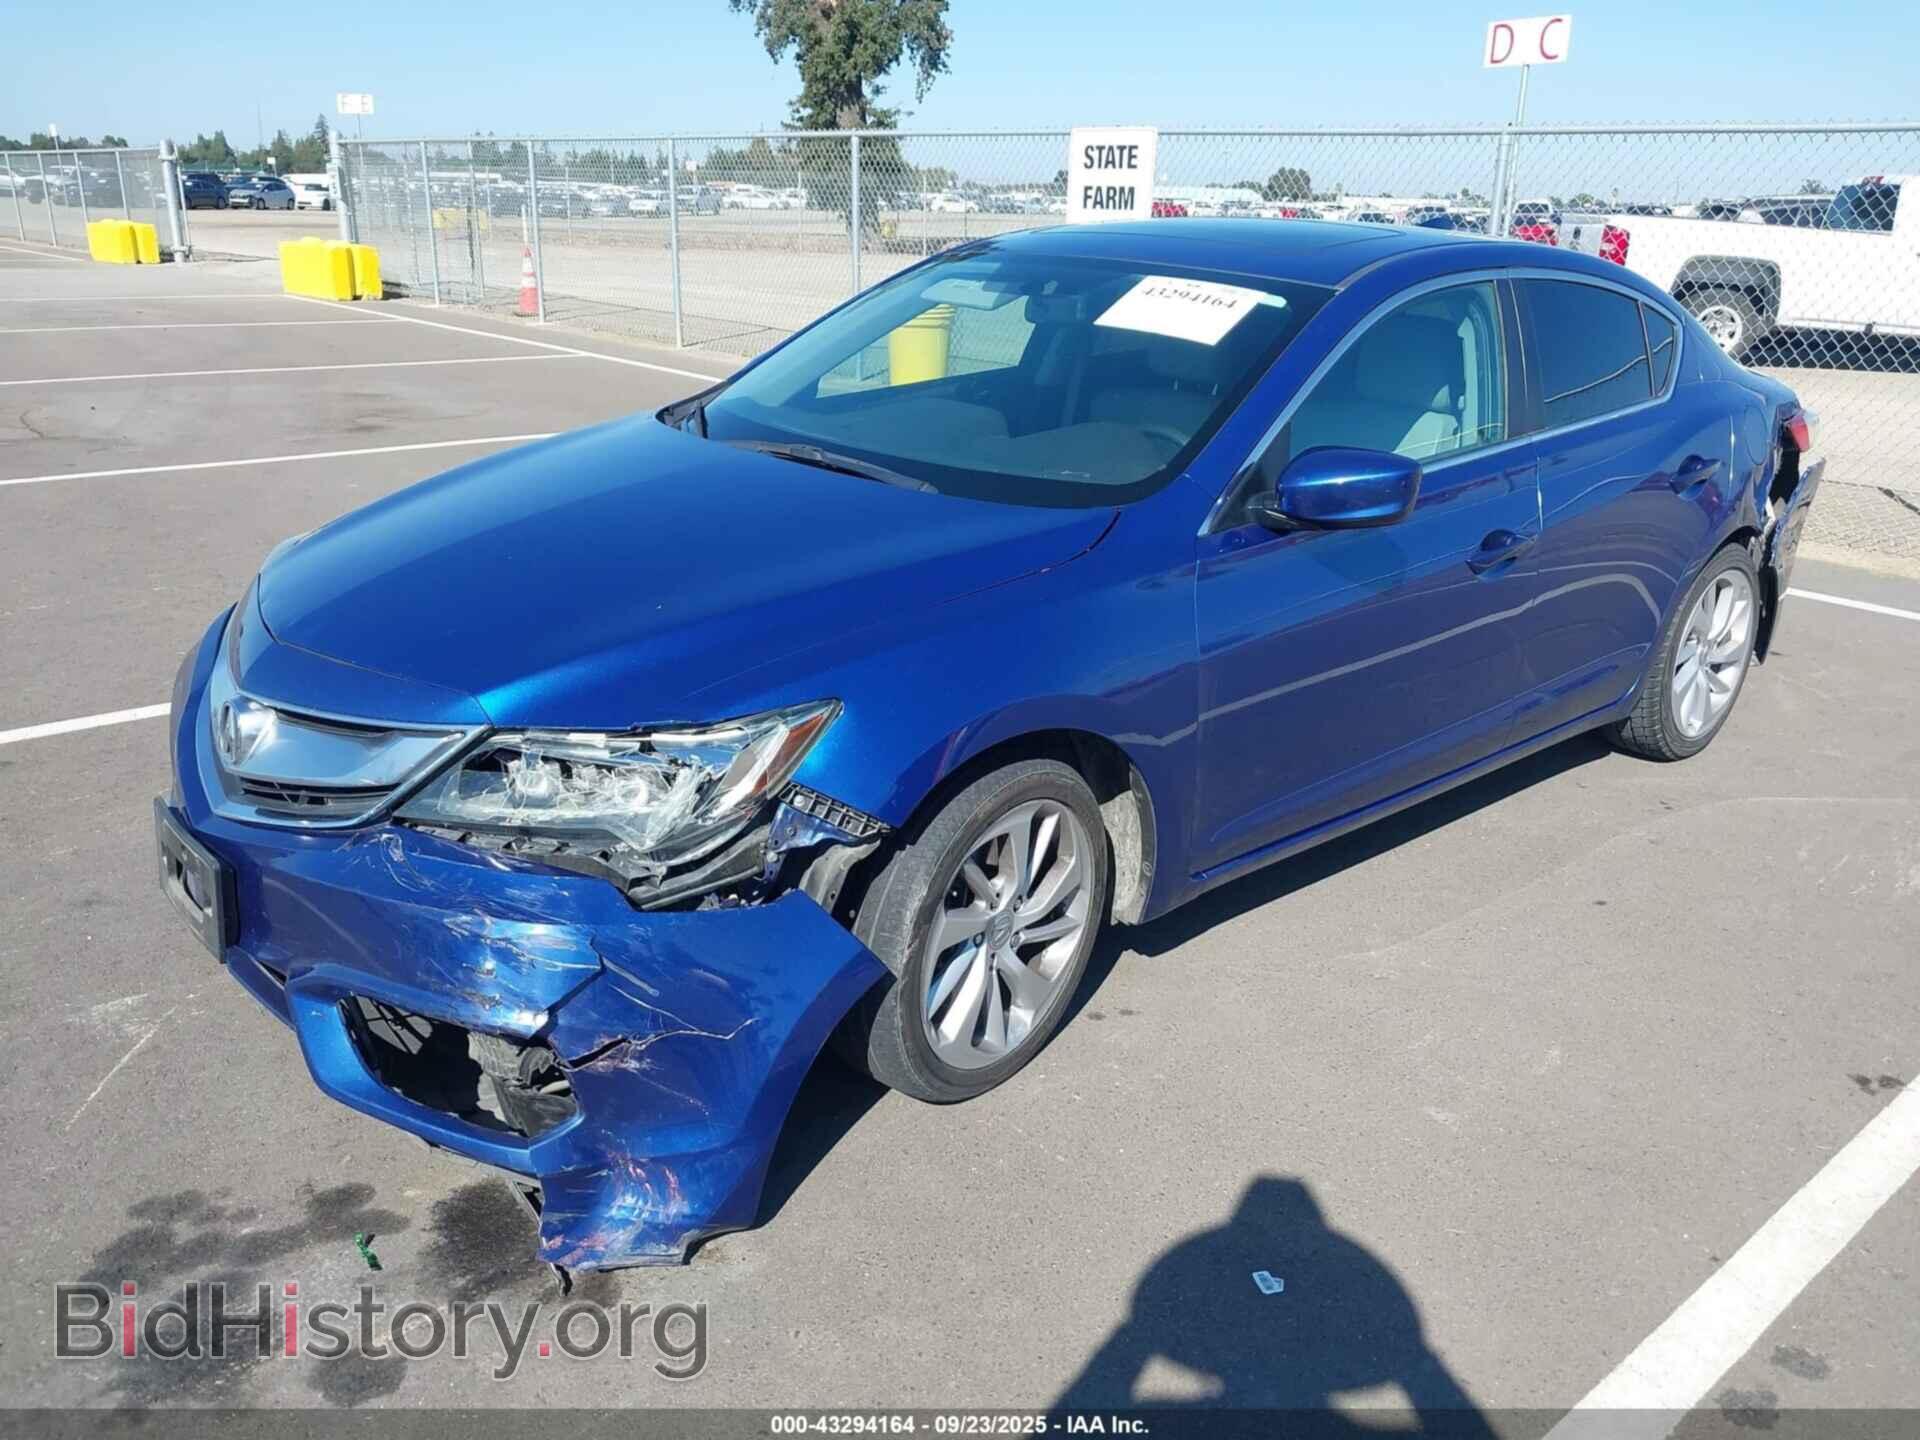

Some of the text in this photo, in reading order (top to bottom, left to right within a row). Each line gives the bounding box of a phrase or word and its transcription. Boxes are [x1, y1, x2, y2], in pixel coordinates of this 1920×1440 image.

[1490, 17, 1563, 64] D C
[1083, 144, 1139, 169] STATE
[1083, 185, 1136, 211] FARM
[1142, 287, 1238, 309] 43294164
